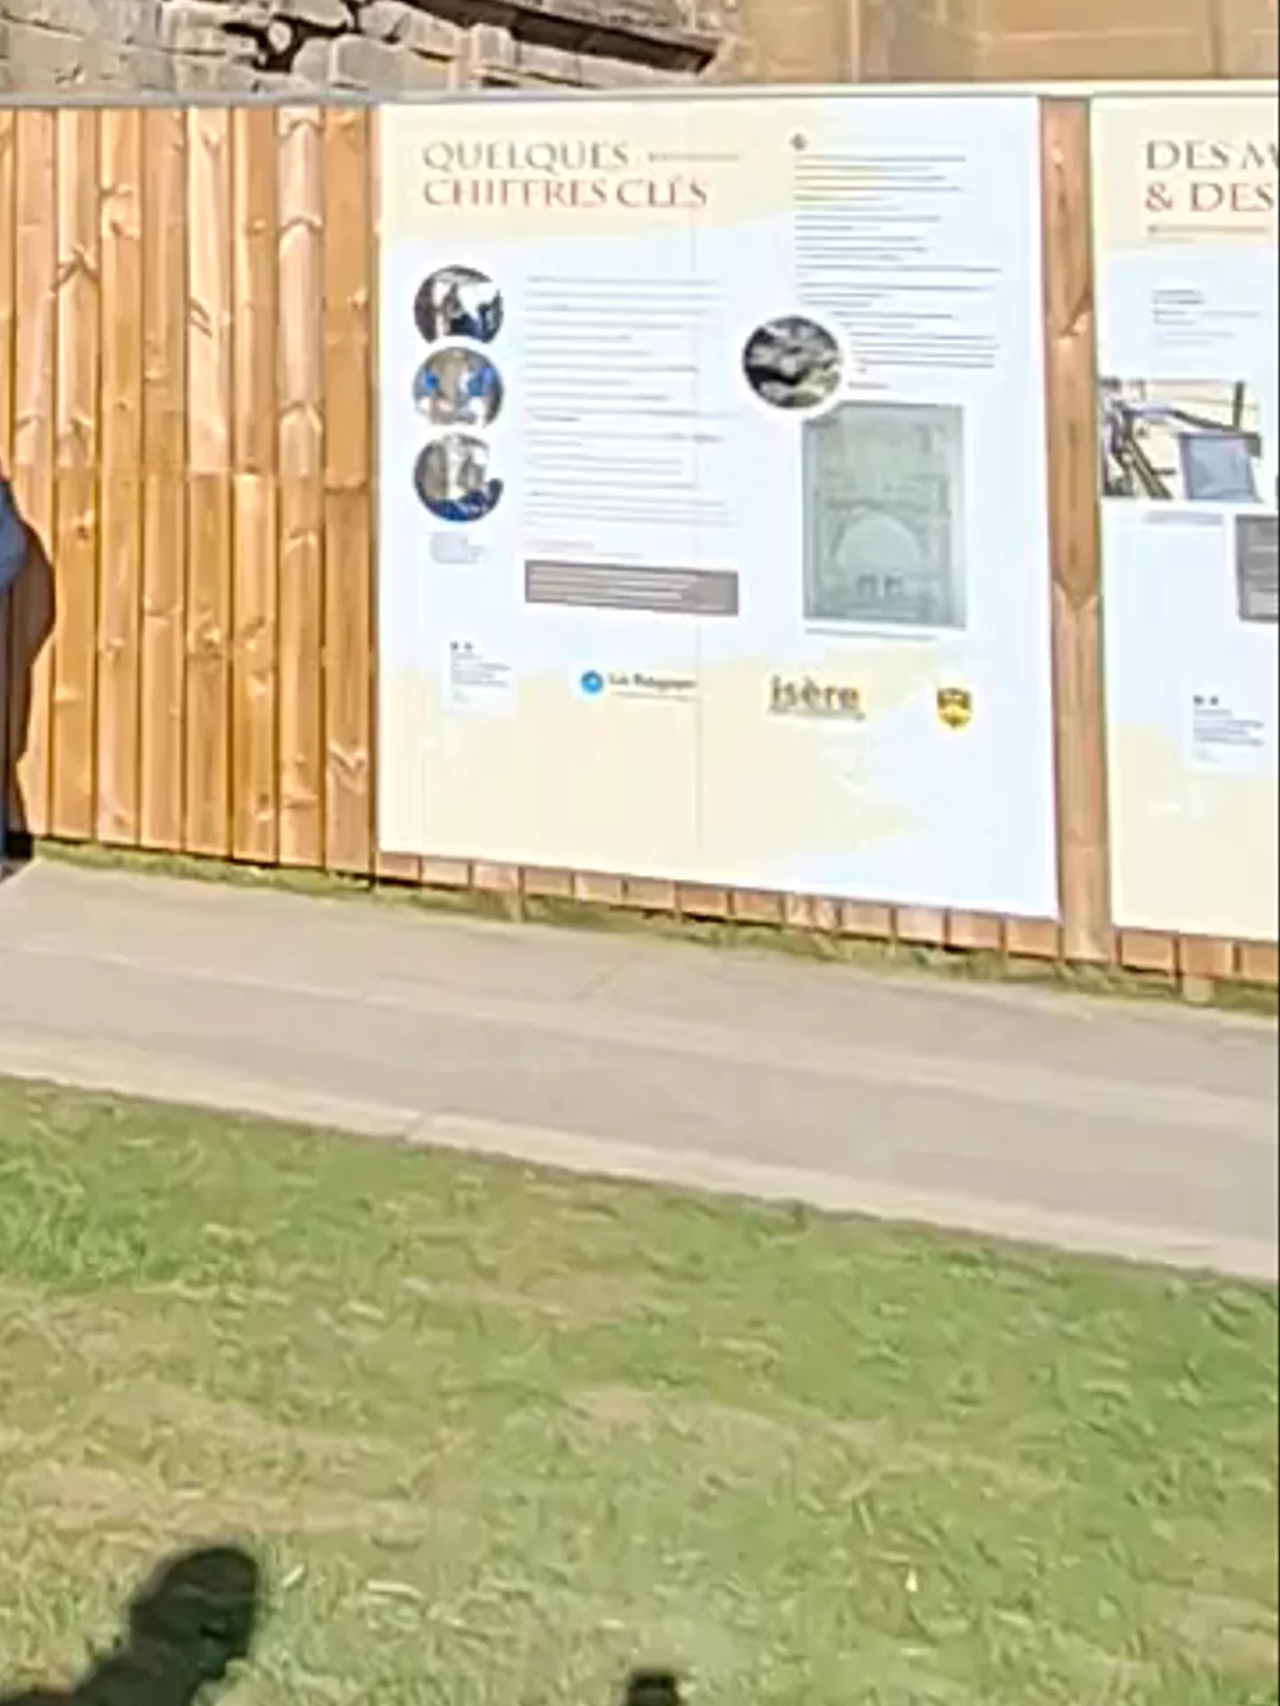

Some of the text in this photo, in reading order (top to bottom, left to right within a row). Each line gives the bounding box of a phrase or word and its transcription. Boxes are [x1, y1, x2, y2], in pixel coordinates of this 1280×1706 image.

[422, 140, 629, 174] QUELQUES
[1146, 139, 1230, 171] DES
[422, 174, 708, 209] CHIFFRES CLÉS
[1144, 182, 1276, 212] & DES
